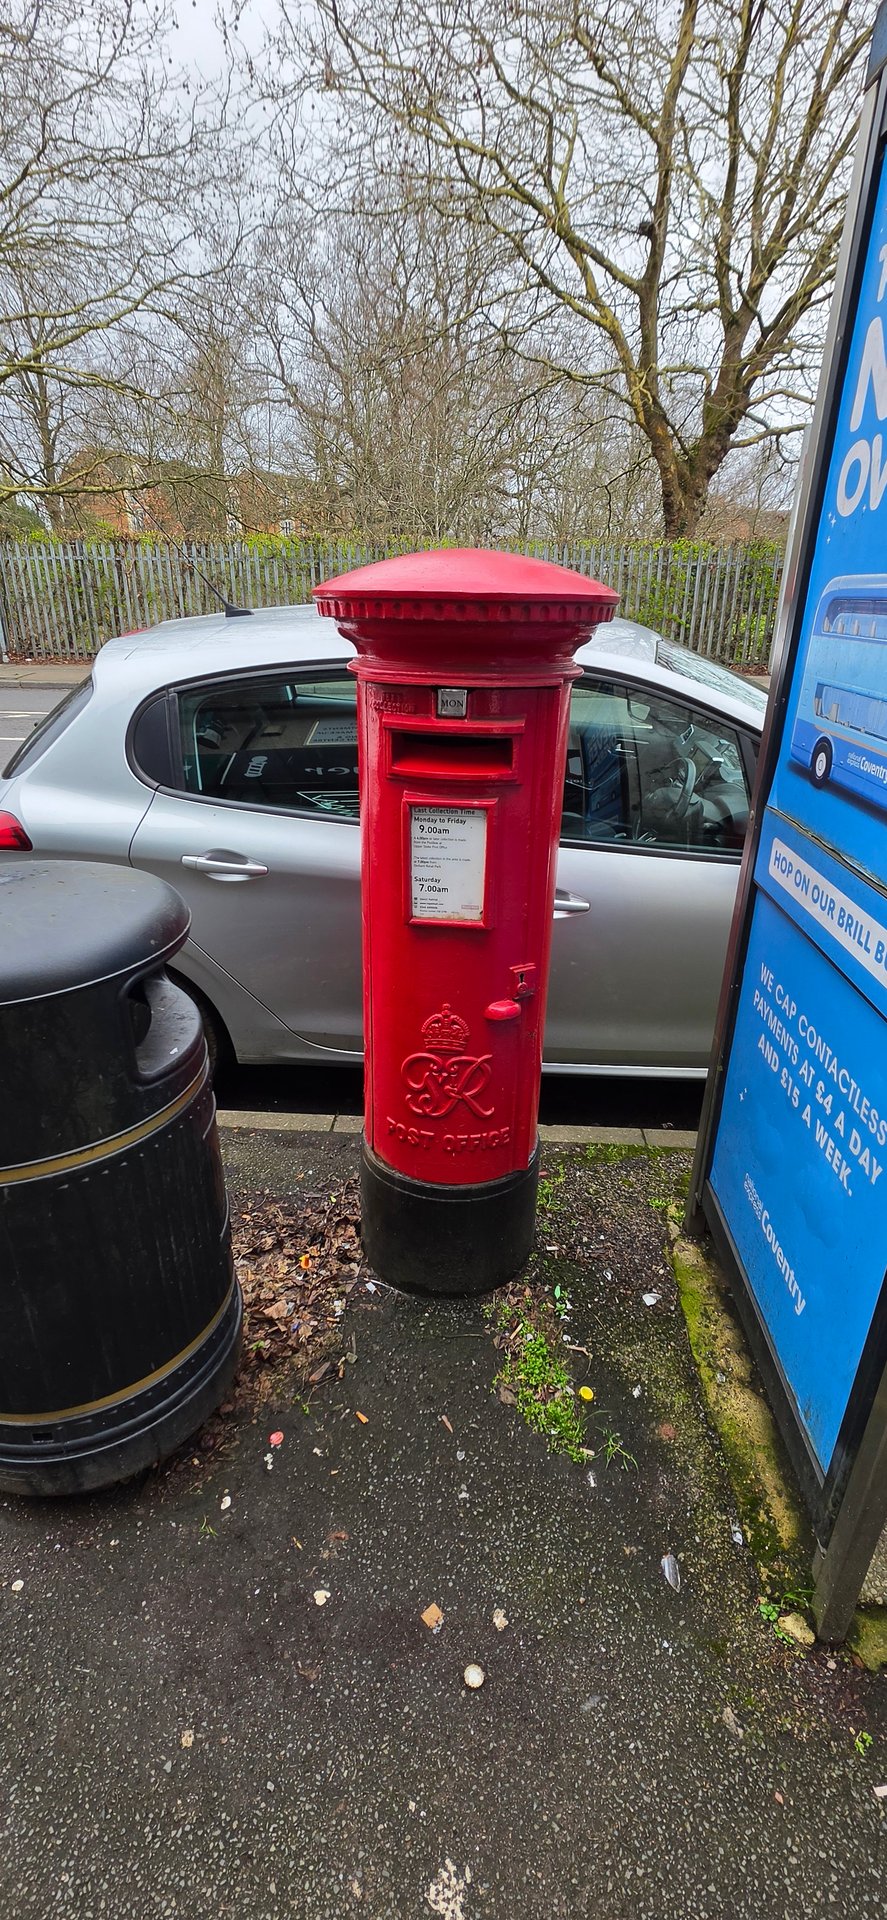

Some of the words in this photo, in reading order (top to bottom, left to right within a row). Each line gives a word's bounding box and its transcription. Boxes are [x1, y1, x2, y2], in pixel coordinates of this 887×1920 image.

[440, 699, 464, 708] MON
[413, 816, 438, 824] Monday
[447, 817, 467, 825] Friday
[428, 807, 459, 815] Collection
[418, 824, 450, 834] 9.00am
[413, 876, 441, 884] Saturday
[418, 883, 449, 893] 7.00am
[773, 849, 793, 878] HOP
[794, 868, 811, 895] ON
[811, 884, 836, 920] OUR
[837, 906, 871, 954] BRILL
[759, 961, 775, 993] WE
[775, 984, 797, 1020] CAP
[798, 1014, 887, 1146] CONTACTLESS
[753, 989, 799, 1065] PAYMENTS
[799, 1059, 816, 1088] AT
[815, 1080, 833, 1116] £4
[834, 1110, 845, 1138] A
[849, 1127, 883, 1185] DAY
[757, 1033, 780, 1073] AND
[780, 1067, 800, 1108] £15
[801, 1104, 811, 1128] A
[815, 1118, 853, 1197] WEEK.
[386, 1116, 434, 1149] POST
[443, 1126, 510, 1151] OFFICE
[761, 1209, 807, 1316] Coventry
